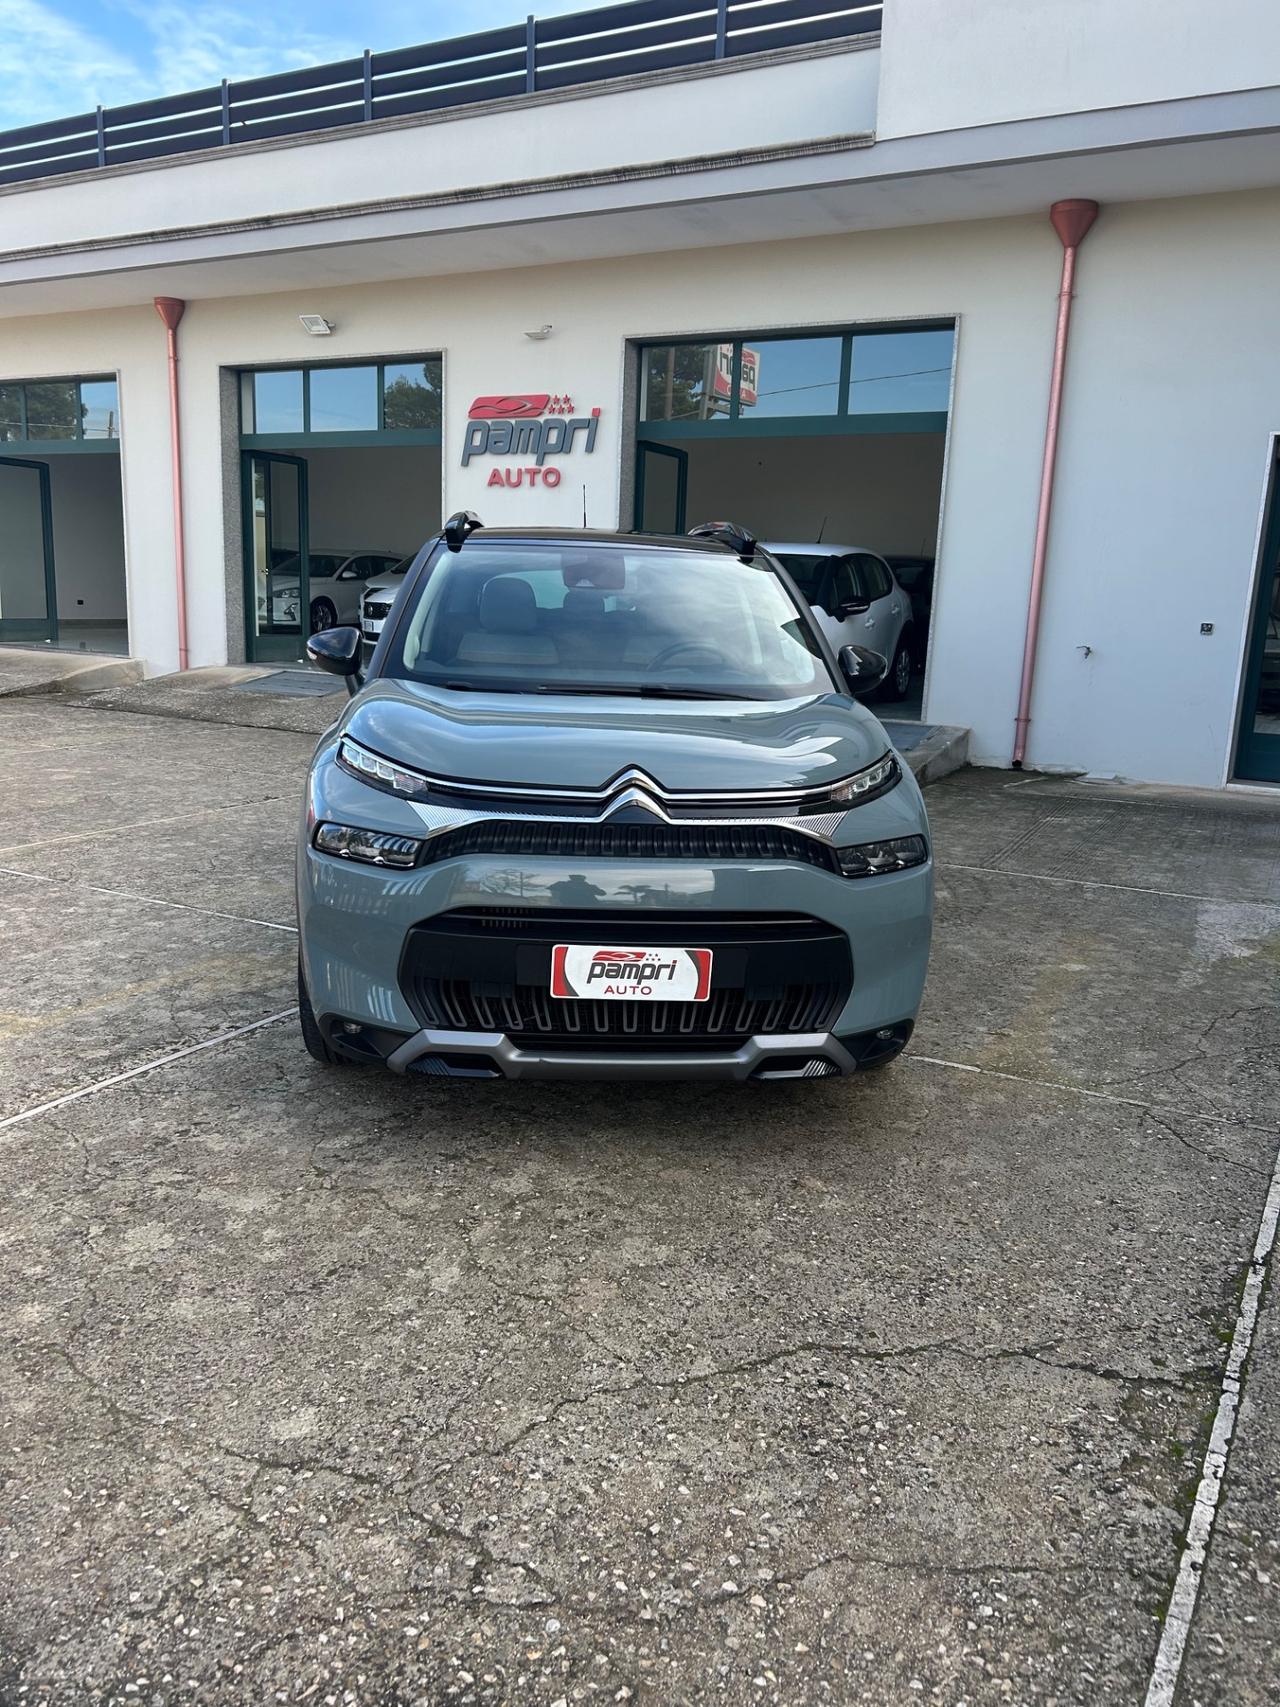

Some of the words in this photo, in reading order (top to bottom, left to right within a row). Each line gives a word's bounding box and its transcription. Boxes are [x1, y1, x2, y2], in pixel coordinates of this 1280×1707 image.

[461, 407, 601, 466] pampri
[487, 468, 561, 487] AUTO
[586, 960, 677, 985] pampri
[604, 985, 652, 995] AUTO
